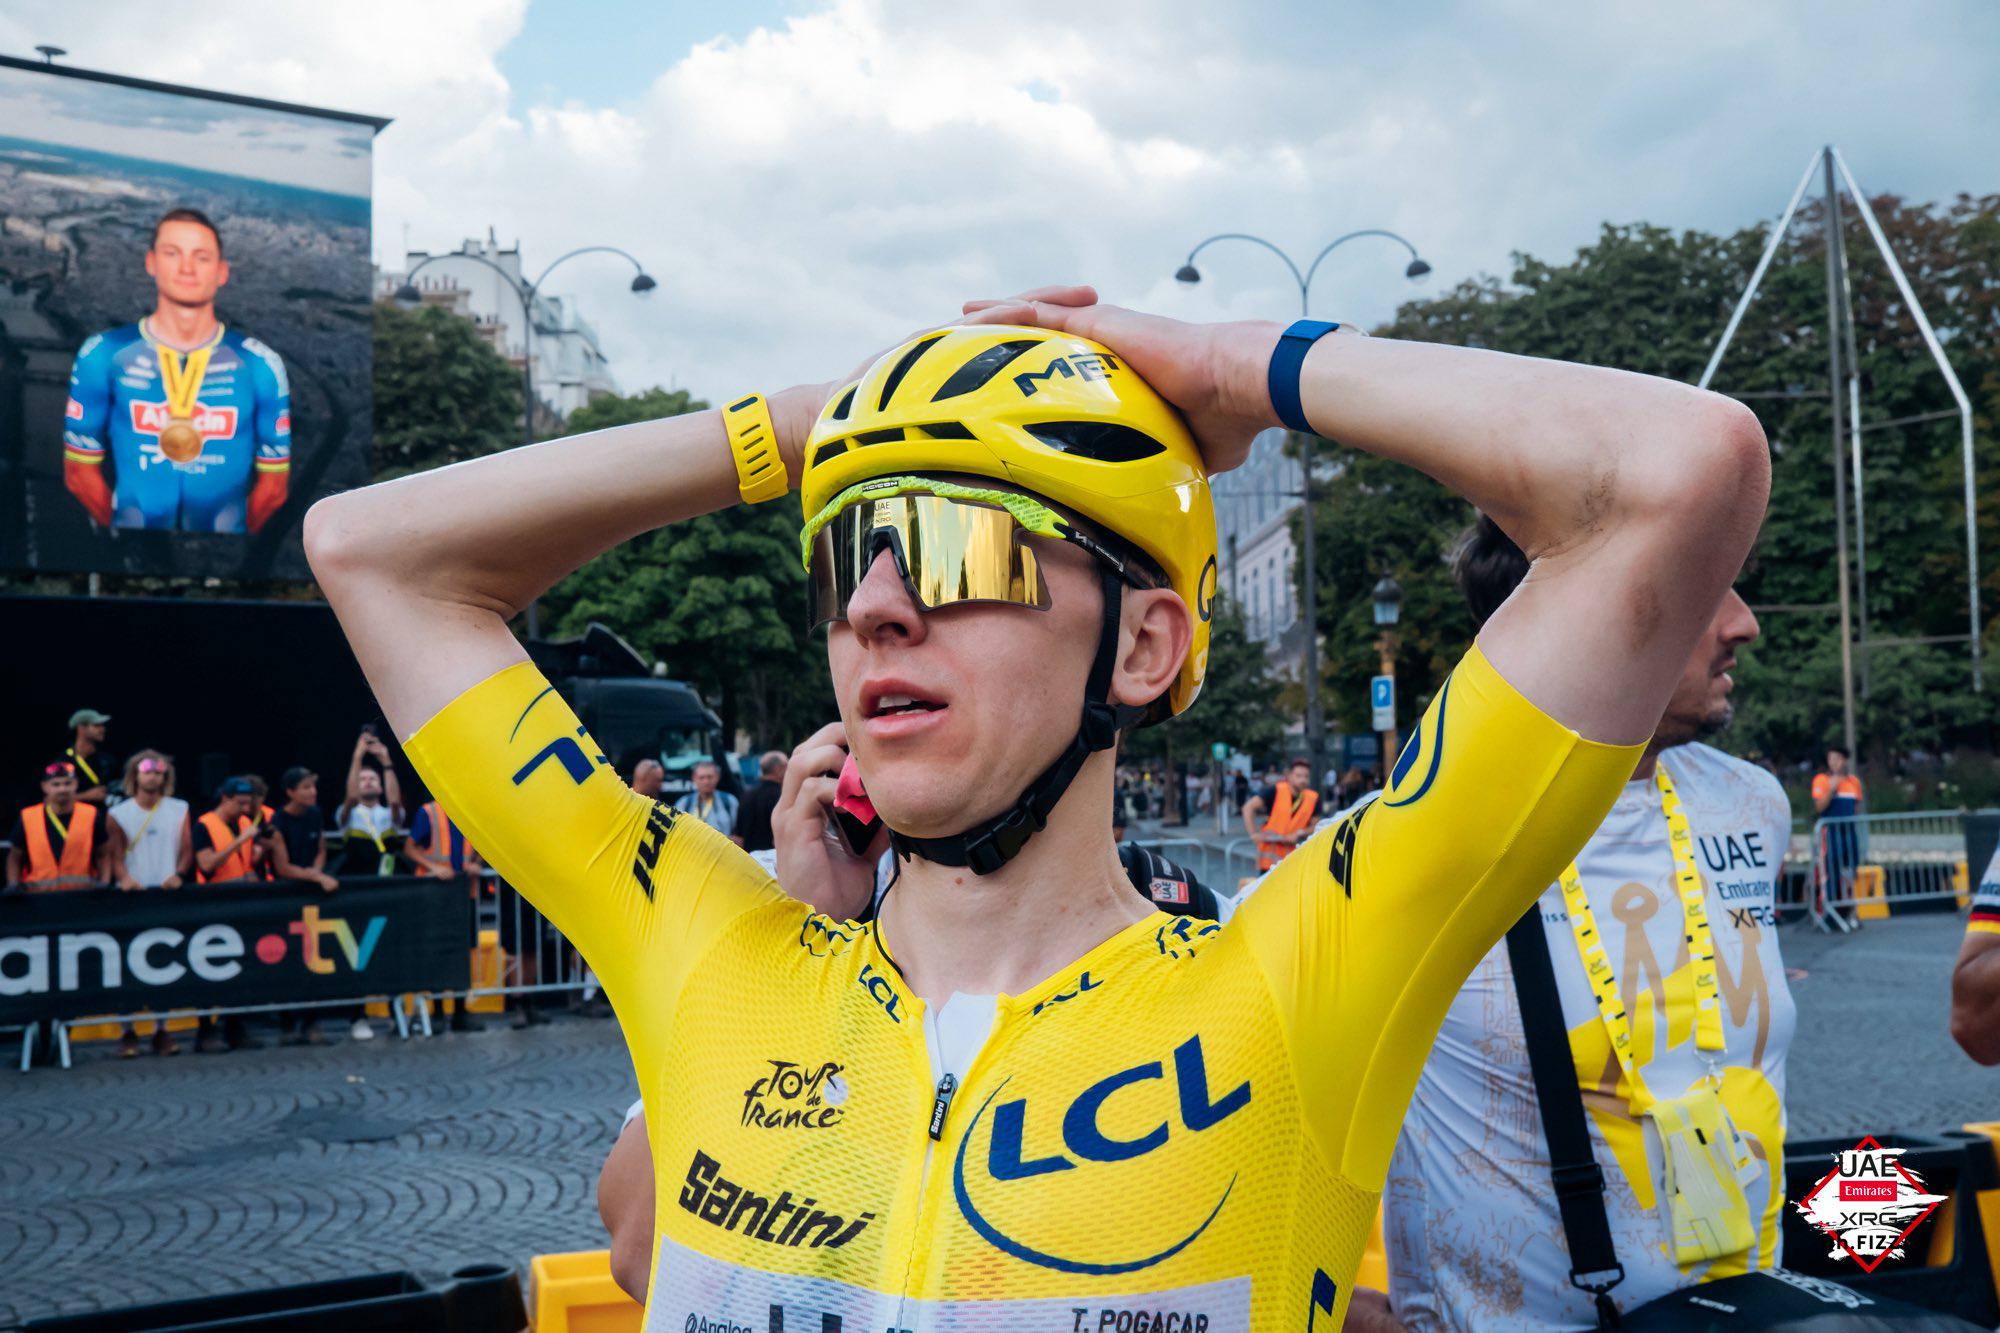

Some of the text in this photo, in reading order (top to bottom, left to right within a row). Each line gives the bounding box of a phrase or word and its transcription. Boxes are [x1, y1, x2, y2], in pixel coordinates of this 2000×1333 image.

[1013, 353, 1120, 397] MET
[1699, 832, 1767, 873] UAE
[806, 1092, 821, 1106] de
[988, 1034, 1252, 1181] LCL
[679, 1149, 876, 1248] Santini
[1072, 1308, 1209, 1333] T. POGACAR
